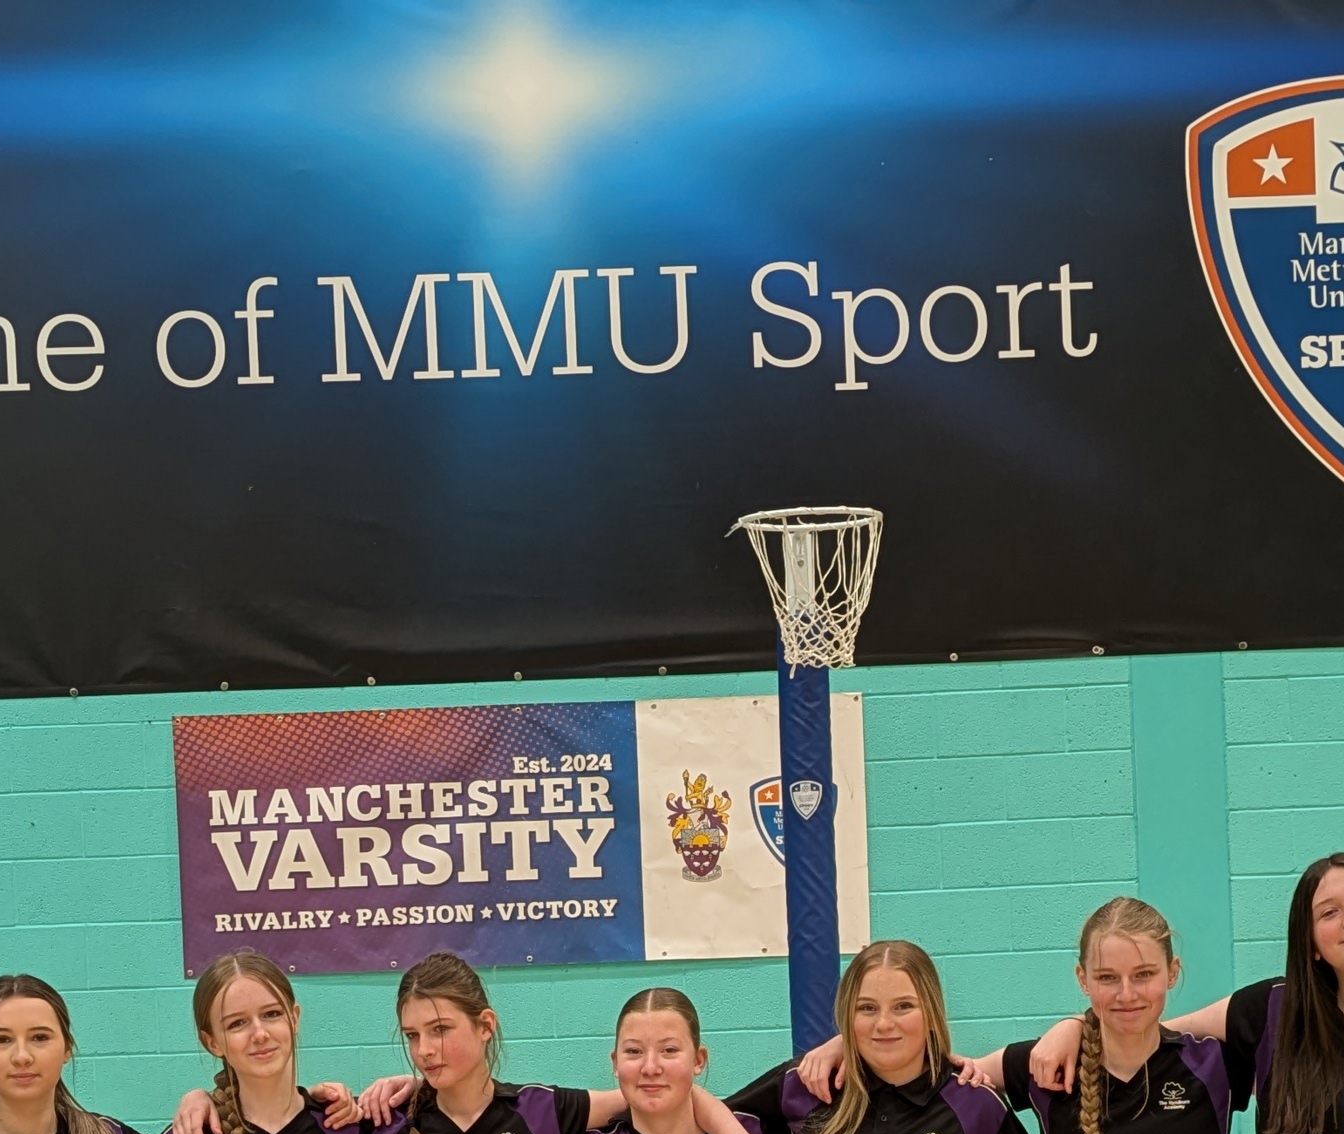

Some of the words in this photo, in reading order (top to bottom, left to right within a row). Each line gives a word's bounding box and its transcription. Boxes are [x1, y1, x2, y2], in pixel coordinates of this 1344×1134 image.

[156, 276, 278, 388] of
[317, 265, 697, 382] MMU
[751, 261, 1098, 391] Sport
[512, 755, 557, 775] Est.
[560, 753, 613, 773] 2024
[208, 776, 614, 827] MANCHESTER
[210, 818, 615, 892] VARSITY
[215, 909, 334, 933] RIVALRY
[355, 904, 474, 927] PASSION
[496, 899, 618, 921] VICTORY
